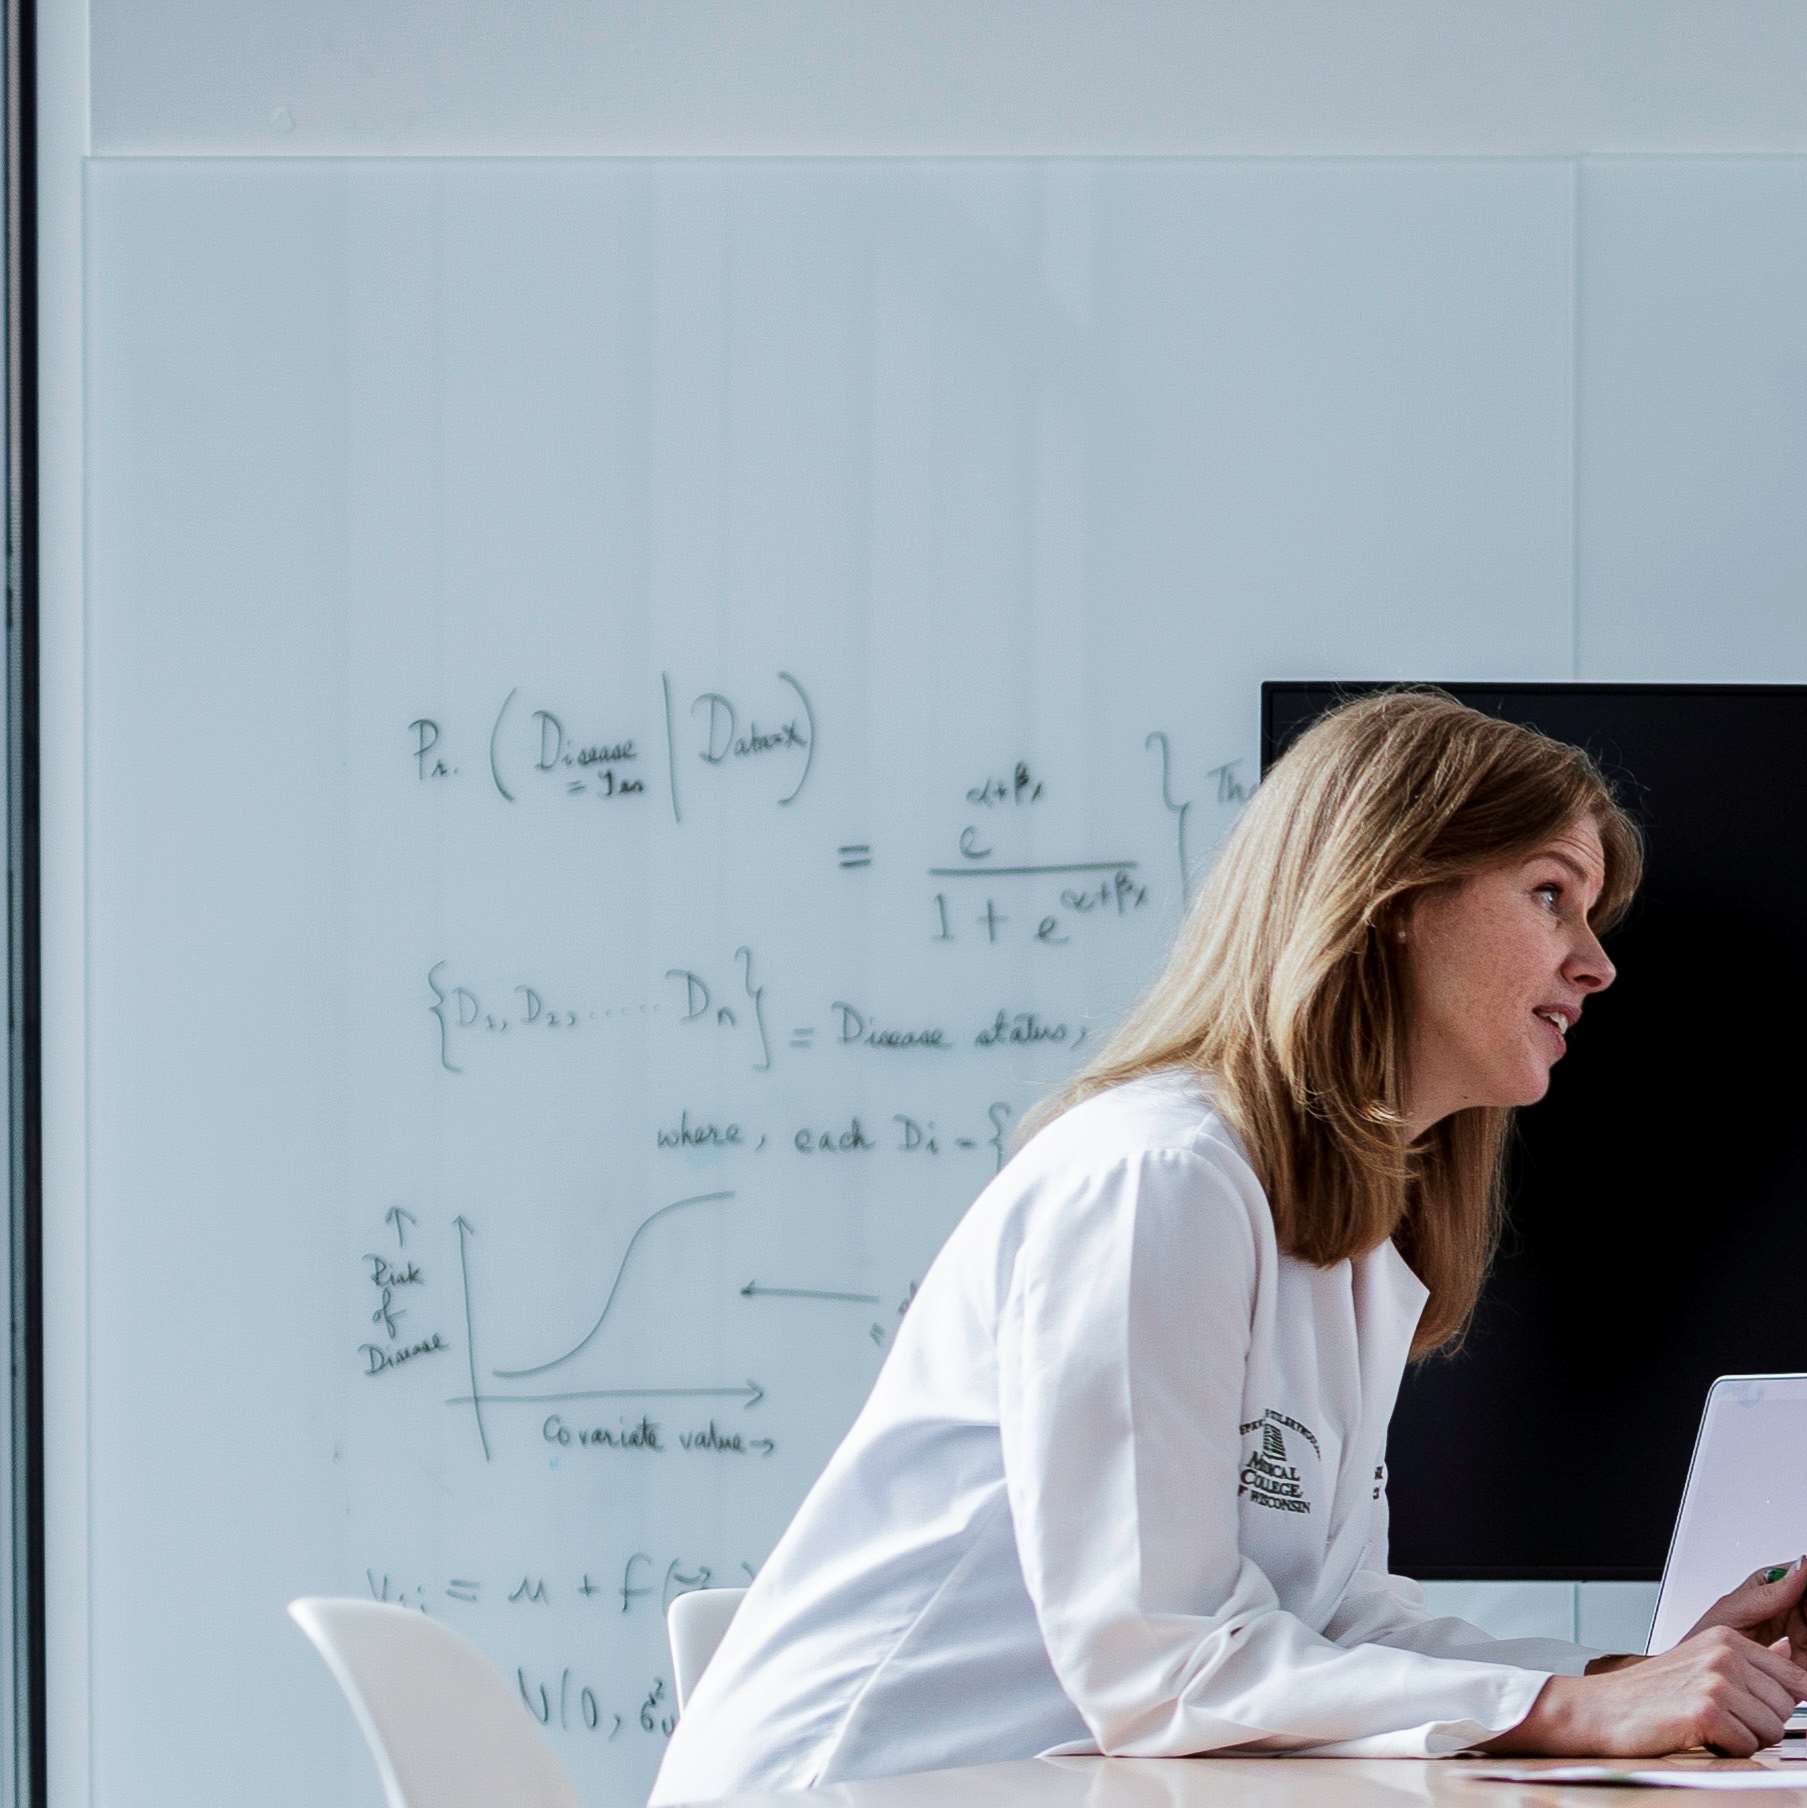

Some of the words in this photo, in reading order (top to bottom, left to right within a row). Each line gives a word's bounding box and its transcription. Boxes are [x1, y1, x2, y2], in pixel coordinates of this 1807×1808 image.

[532, 710, 638, 771] Disease
[830, 1000, 953, 1051] Disease
[793, 1116, 877, 1155] each
[372, 1287, 407, 1340] of
[358, 1332, 450, 1376] Disease
[543, 1414, 665, 1452] Covariate
[678, 1419, 747, 1453] value
